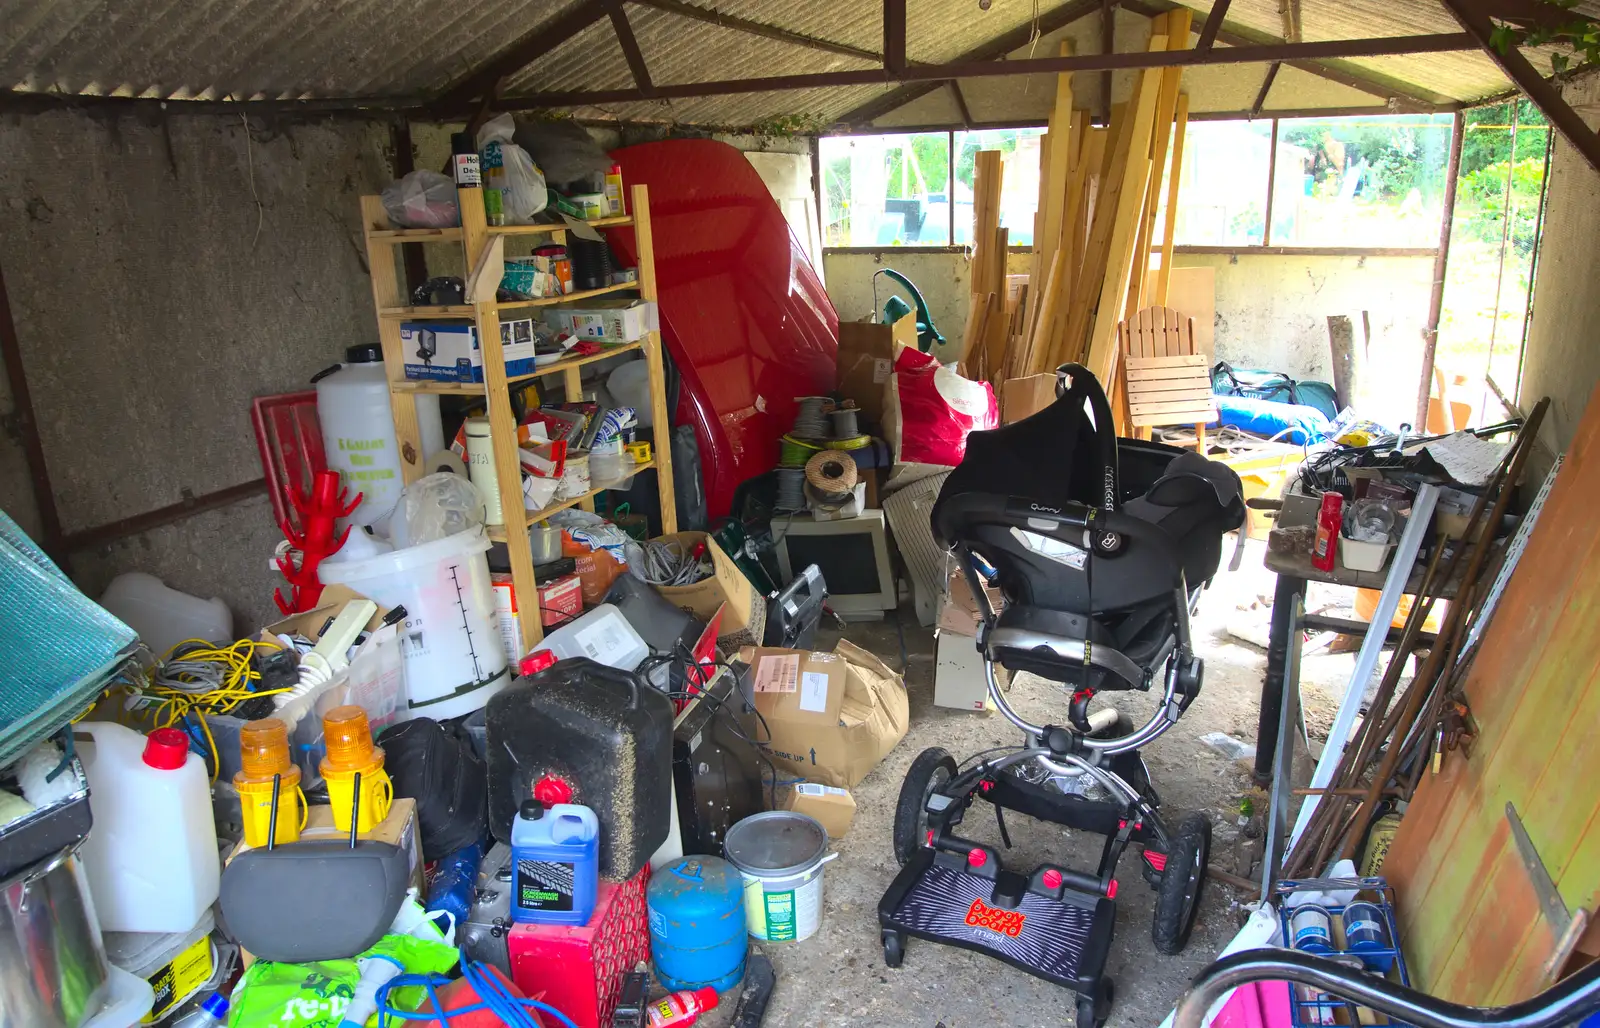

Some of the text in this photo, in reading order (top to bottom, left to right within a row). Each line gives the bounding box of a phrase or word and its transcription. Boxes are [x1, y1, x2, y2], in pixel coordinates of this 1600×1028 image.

[346, 438, 385, 451] GALLON
[1031, 503, 1061, 514] Quinny
[794, 754, 804, 762] UP
[970, 898, 1026, 924] buggy
[965, 908, 1022, 937] board
[973, 928, 1005, 943] maxi
[153, 971, 173, 994] RADE
[156, 984, 171, 1002] BOX
[658, 1000, 674, 1019] T-CUT
